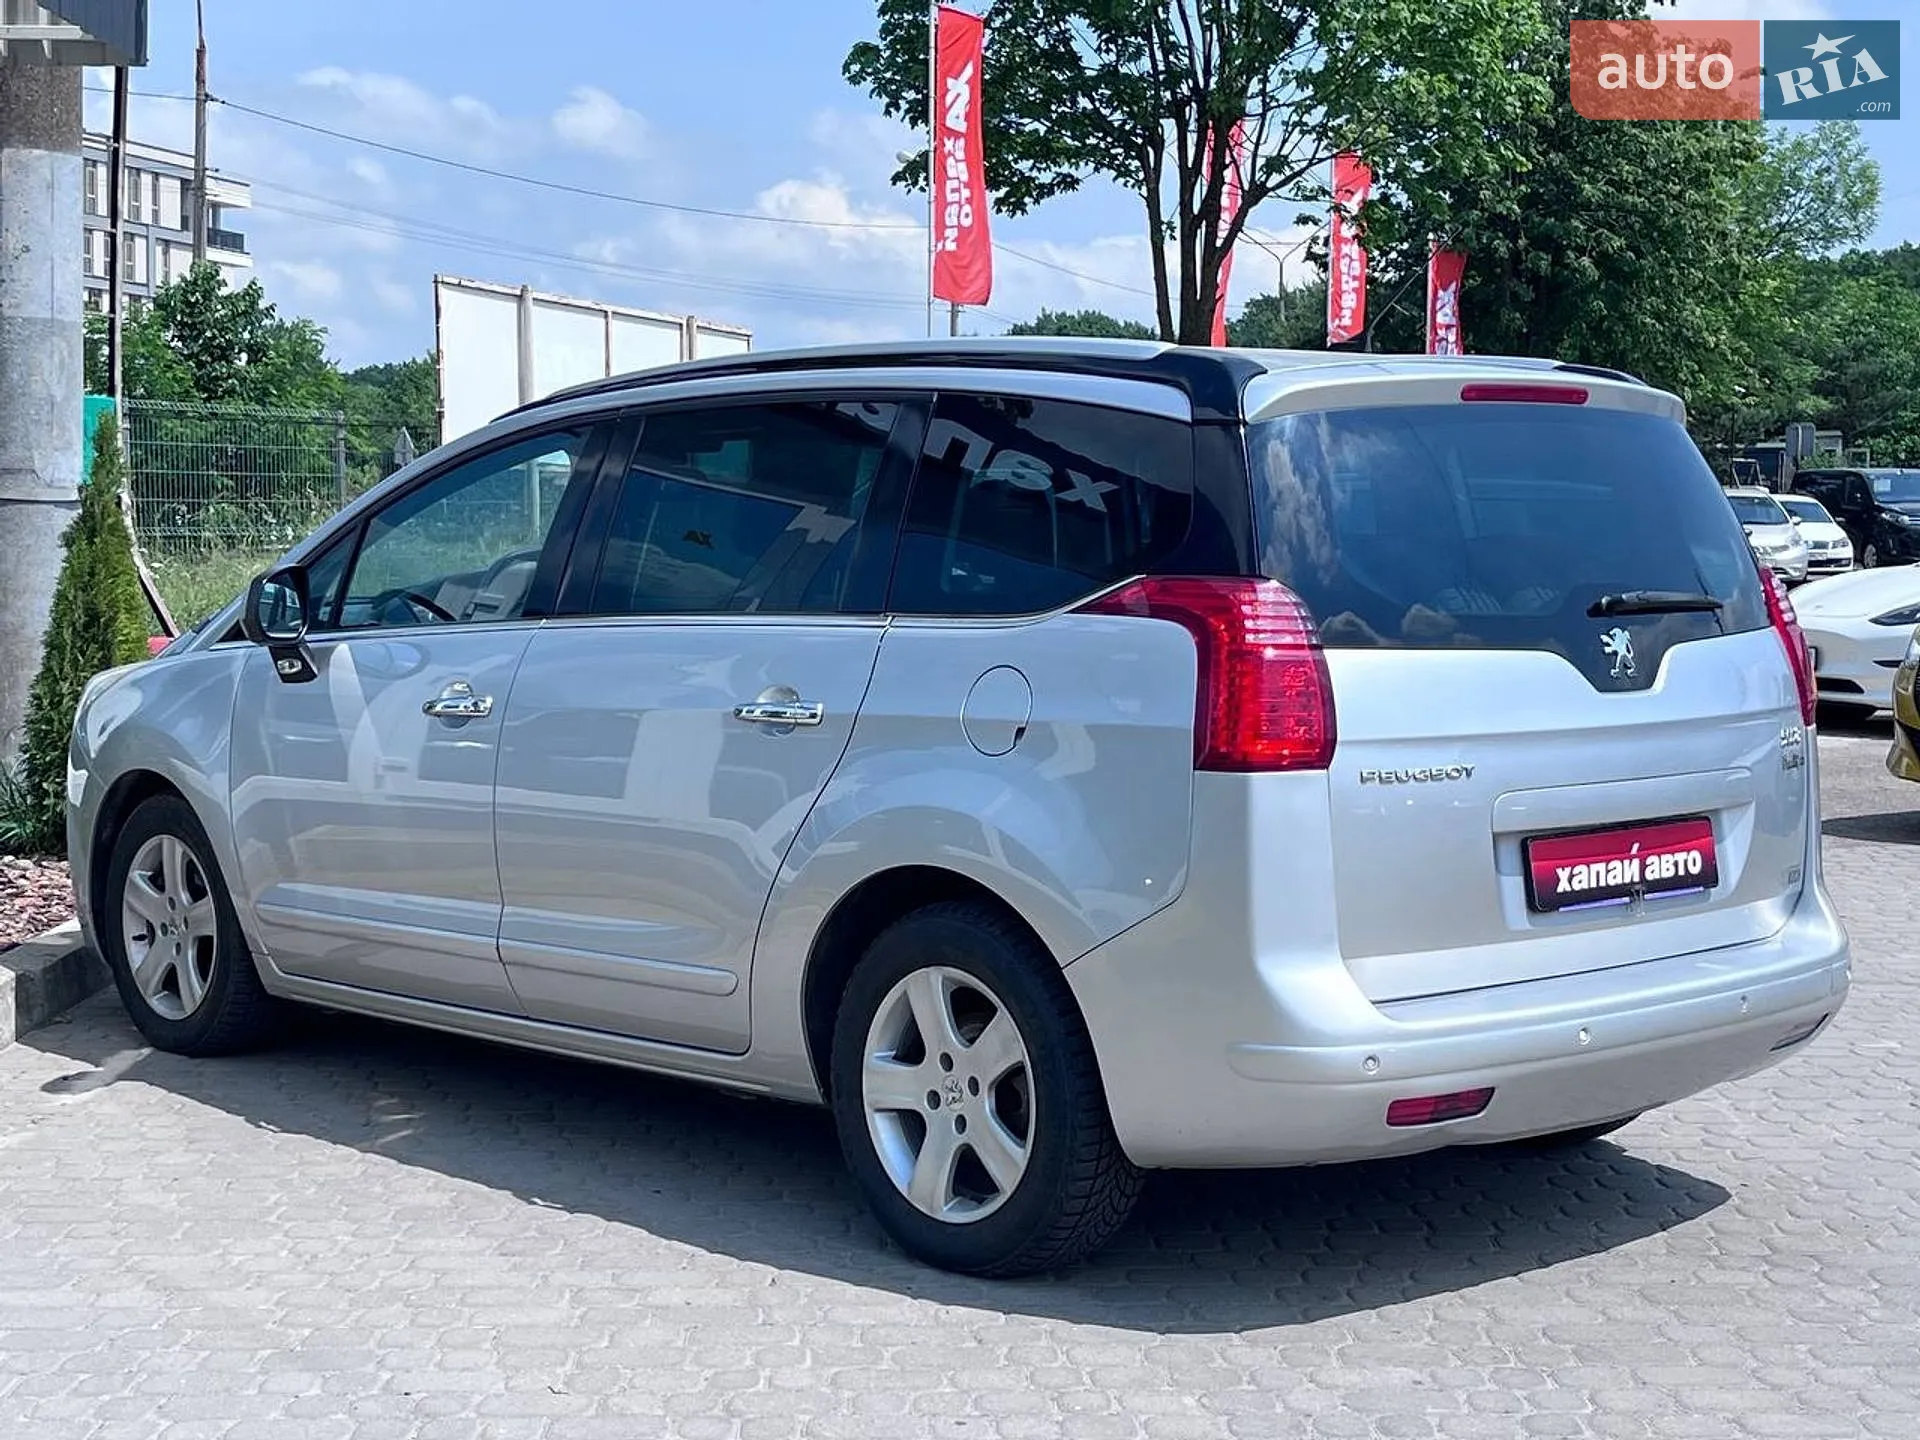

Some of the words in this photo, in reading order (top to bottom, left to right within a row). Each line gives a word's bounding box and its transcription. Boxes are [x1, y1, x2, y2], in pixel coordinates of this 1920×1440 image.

[1359, 764, 1476, 785] PEUGEOT
[1556, 843, 1640, 893] хапай
[1645, 850, 1703, 881] авто
